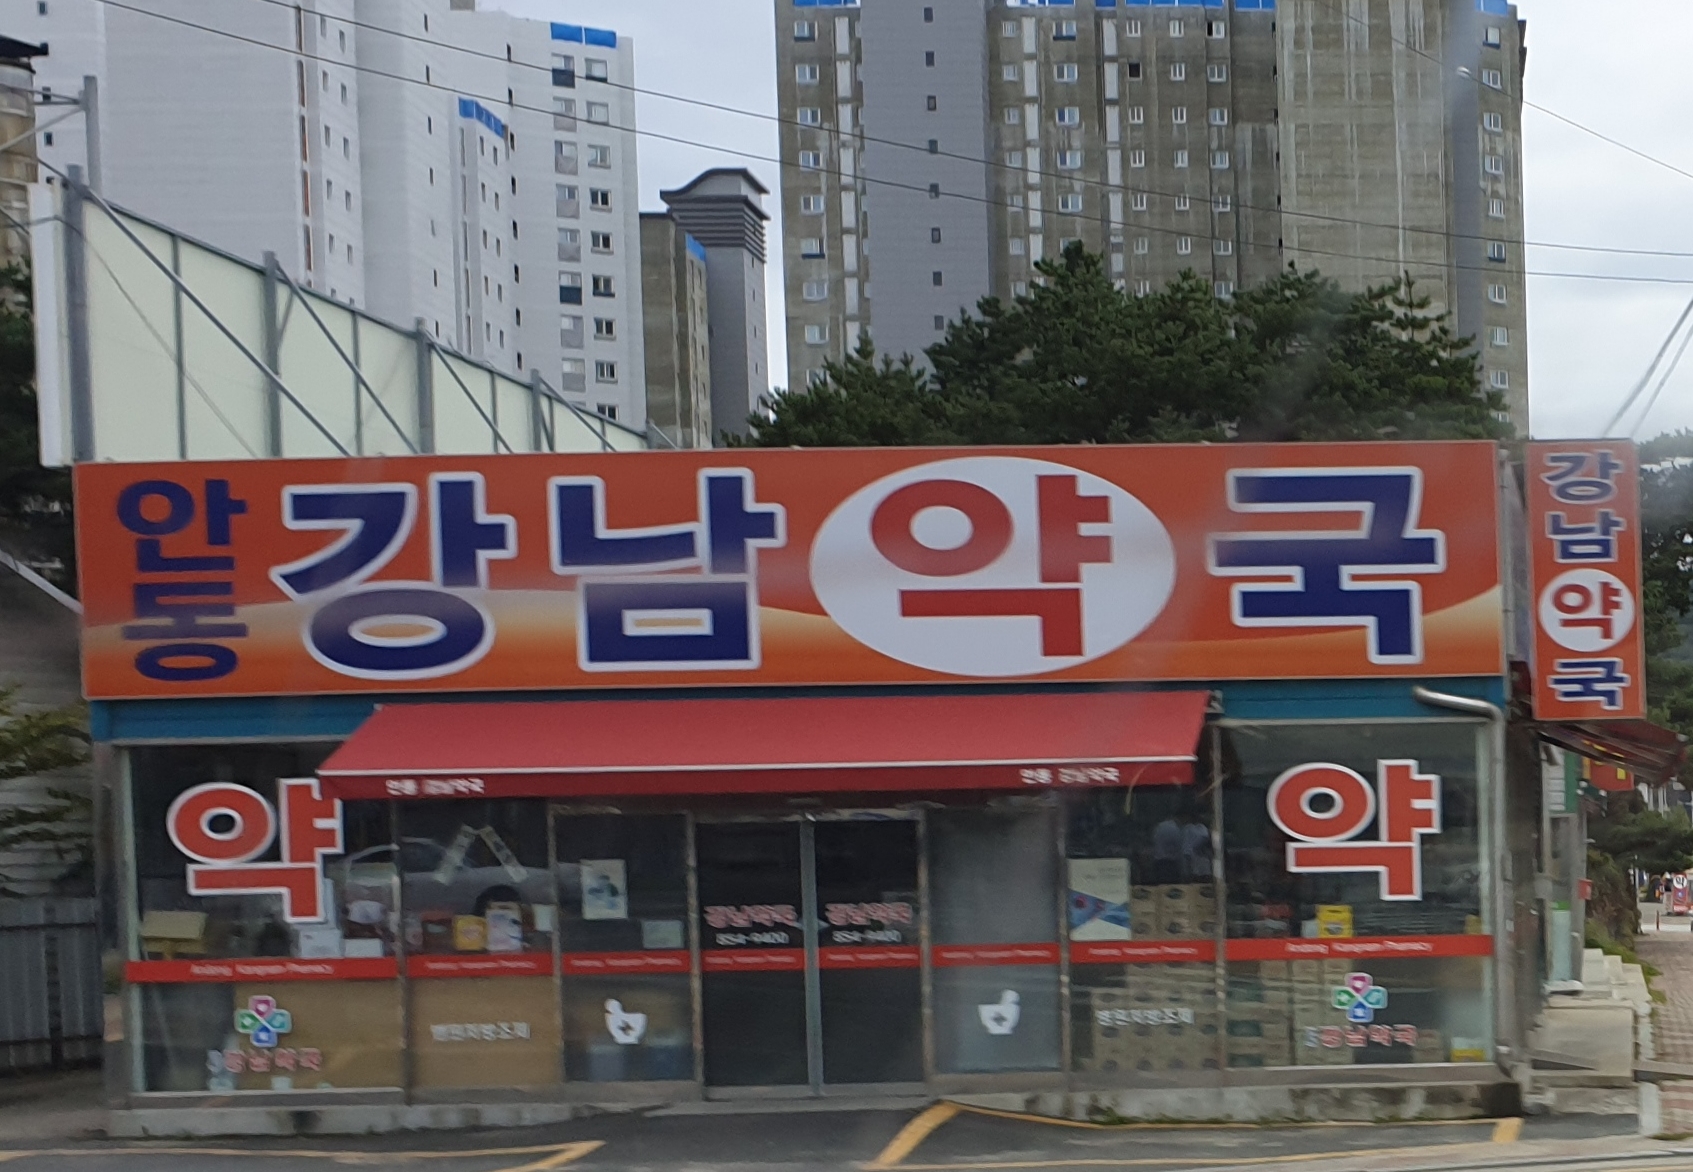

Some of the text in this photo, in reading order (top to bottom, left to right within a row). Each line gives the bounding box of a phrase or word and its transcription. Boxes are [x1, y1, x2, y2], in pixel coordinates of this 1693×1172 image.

[116, 478, 248, 681] 안동
[1540, 449, 1632, 711] 강남약국
[166, 778, 345, 923] 약
[1266, 758, 1442, 901] 약
